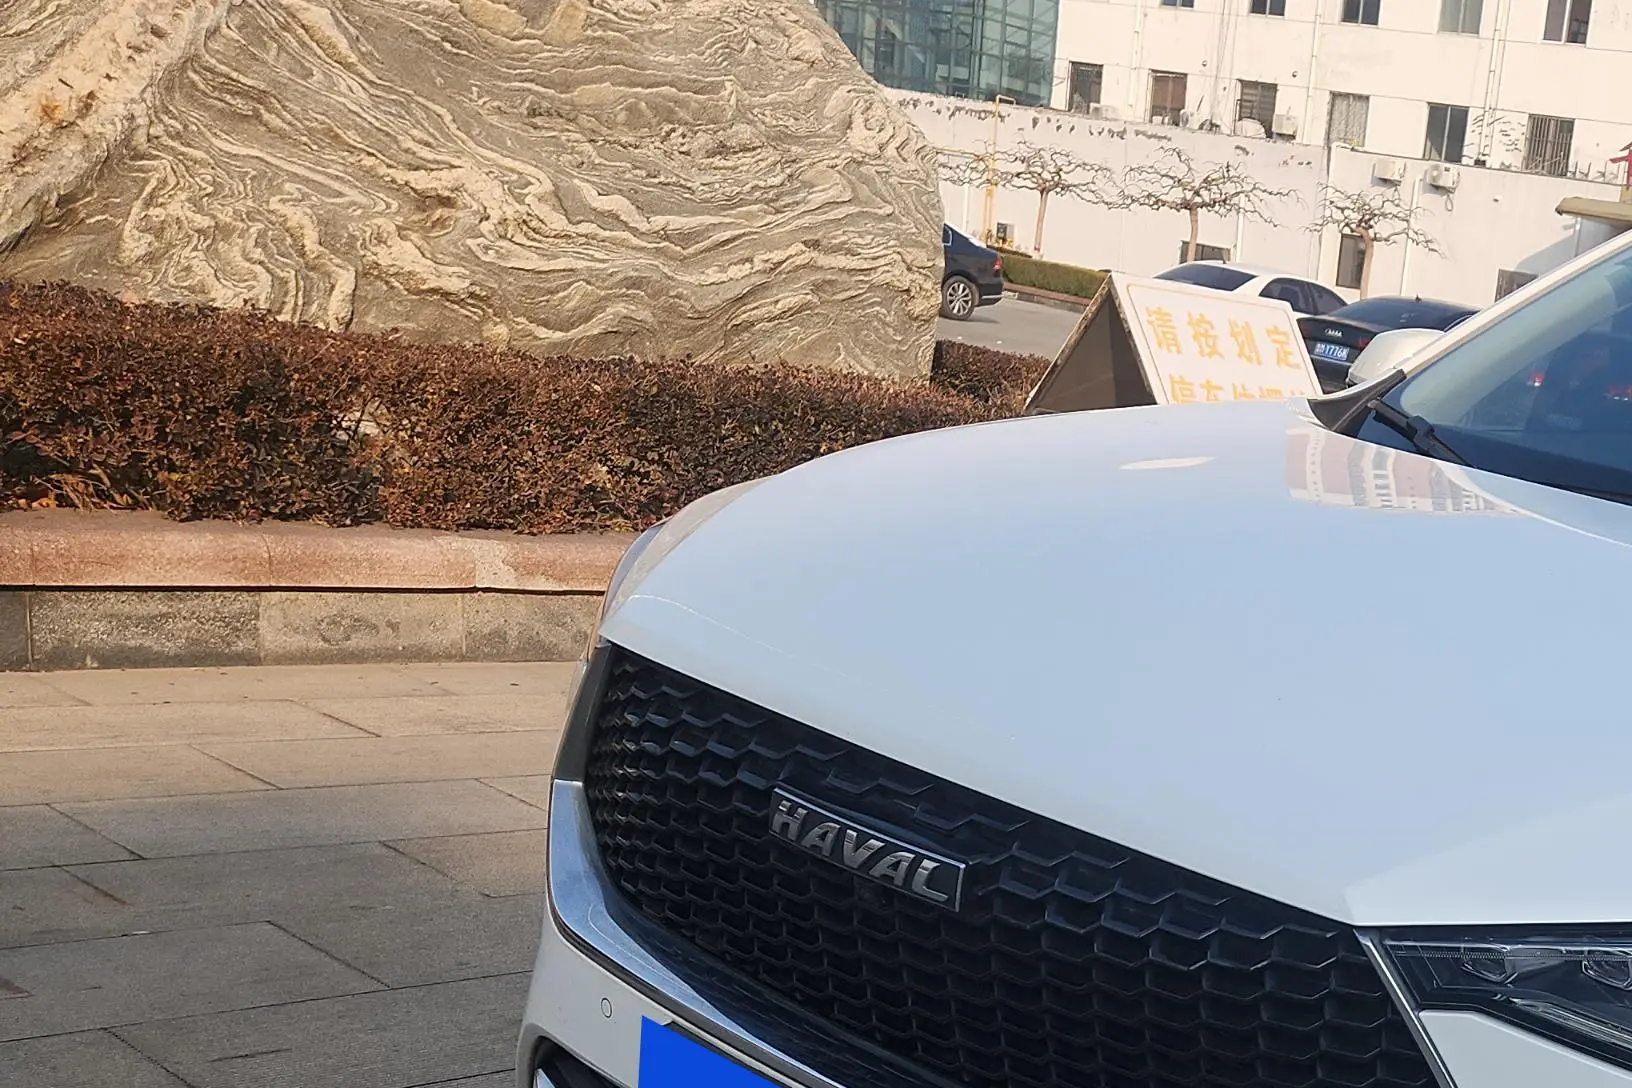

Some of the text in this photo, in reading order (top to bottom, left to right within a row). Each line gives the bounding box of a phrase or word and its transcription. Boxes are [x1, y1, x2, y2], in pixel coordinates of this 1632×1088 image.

[1144, 305, 1302, 370] 请按划定
[771, 799, 951, 902] HAVAL
